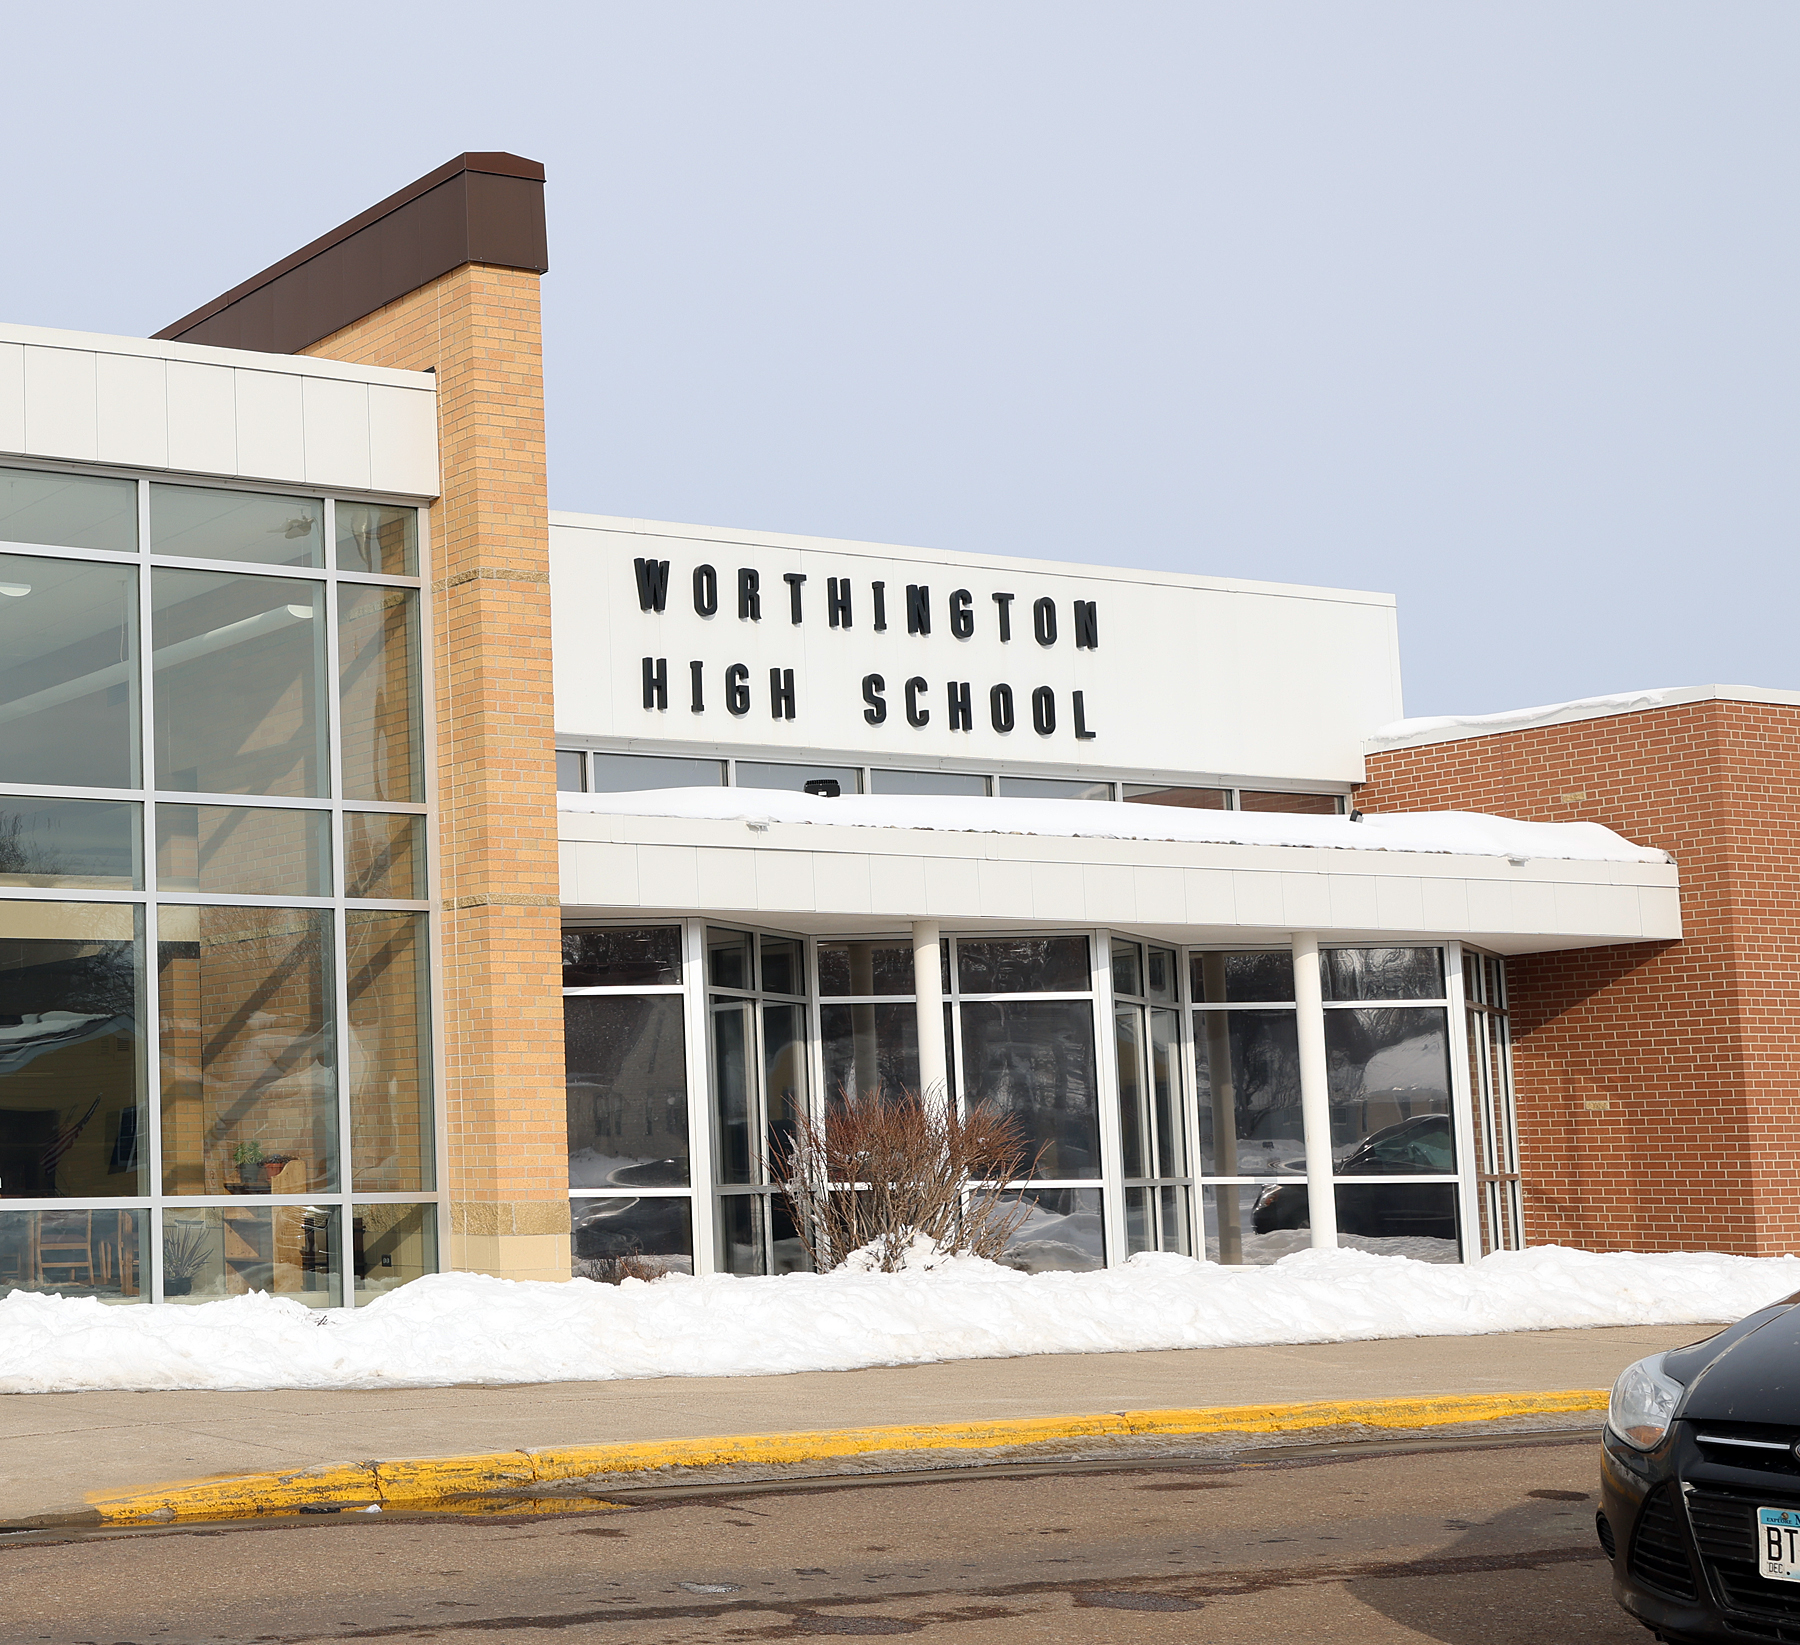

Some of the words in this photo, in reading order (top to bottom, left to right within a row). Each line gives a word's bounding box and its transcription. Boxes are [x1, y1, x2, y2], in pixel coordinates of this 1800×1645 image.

[633, 557, 1099, 650] WORTHINGTON
[642, 656, 796, 720] HIGH
[861, 672, 1097, 740] SCHOOL
[1767, 1526, 1798, 1563] BT
[1768, 1562, 1783, 1573] DEC
